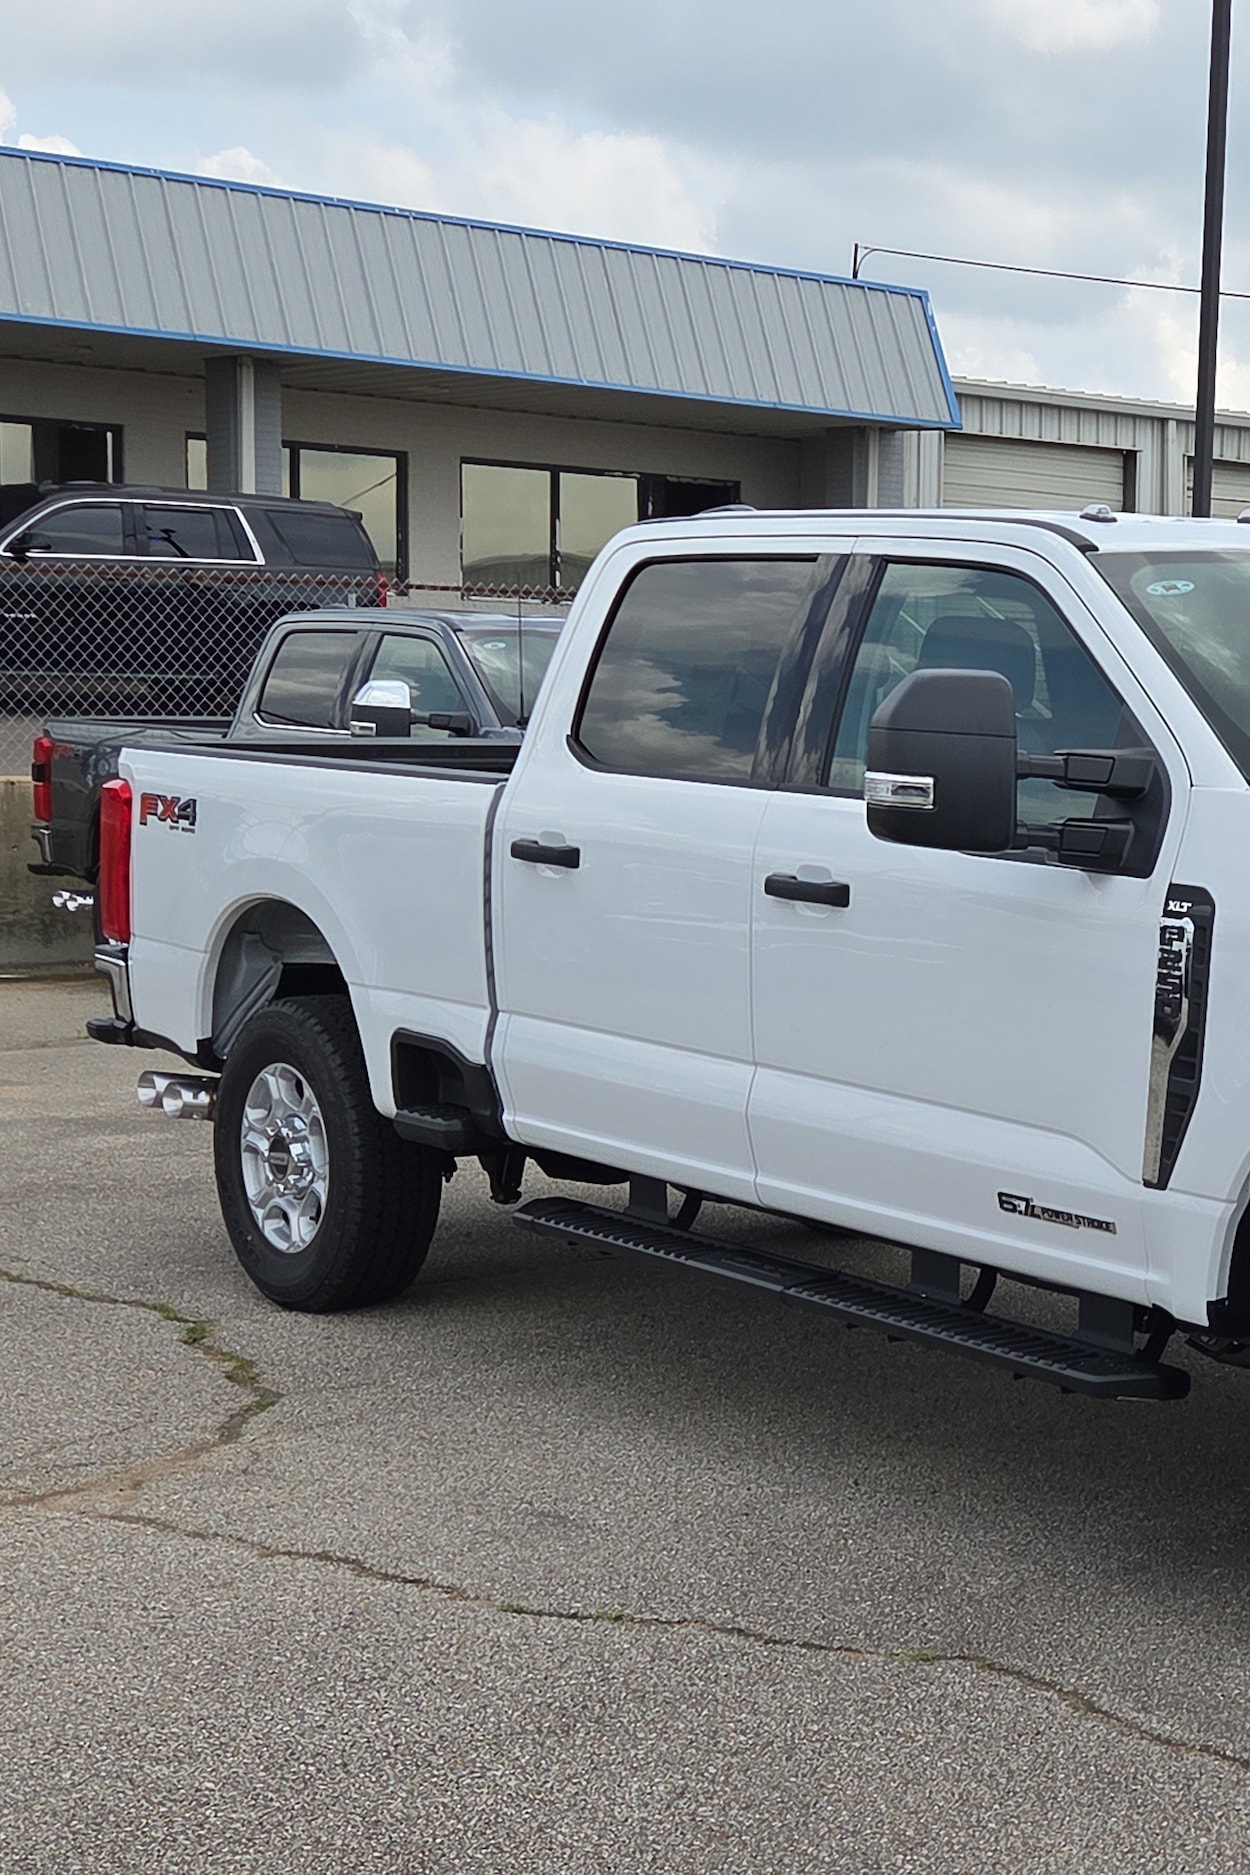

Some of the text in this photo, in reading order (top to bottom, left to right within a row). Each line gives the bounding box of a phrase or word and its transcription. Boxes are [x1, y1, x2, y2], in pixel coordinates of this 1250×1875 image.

[139, 792, 197, 826] FX4
[1166, 900, 1192, 912] XLT
[997, 1191, 1042, 1220] 6.7L
[1074, 1215, 1116, 1234] STROKE
